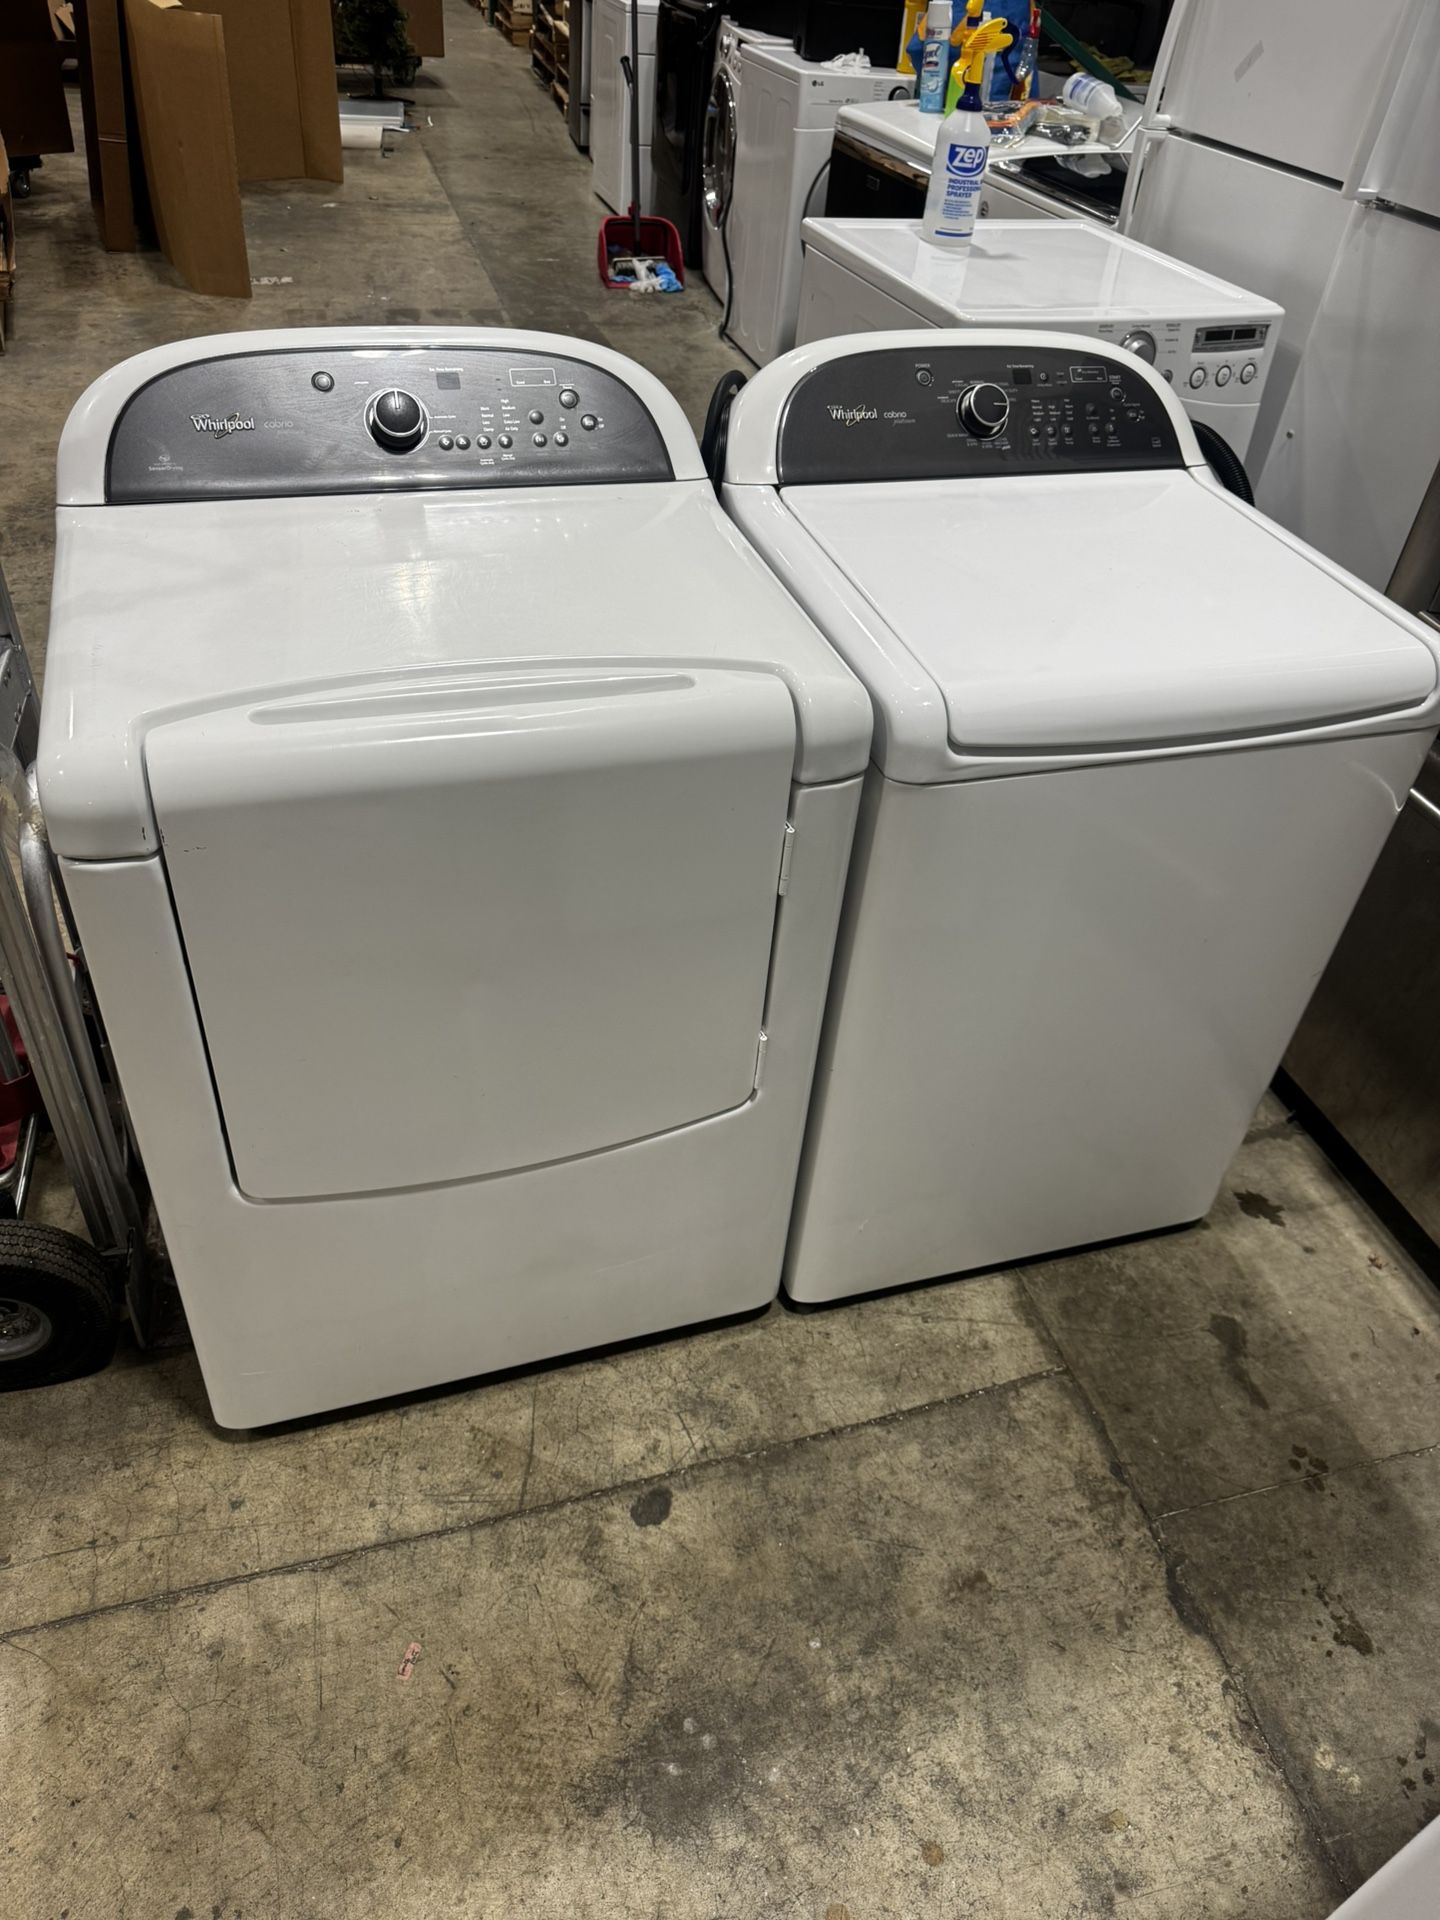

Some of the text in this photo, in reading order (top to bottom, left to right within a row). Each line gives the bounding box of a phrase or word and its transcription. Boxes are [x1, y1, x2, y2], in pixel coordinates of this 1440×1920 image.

[951, 146, 985, 169] Zep
[946, 190, 973, 199] SPRAYER
[828, 408, 878, 423] Whirlpool
[883, 410, 907, 419] cabrio
[191, 415, 256, 435] Whirlpool
